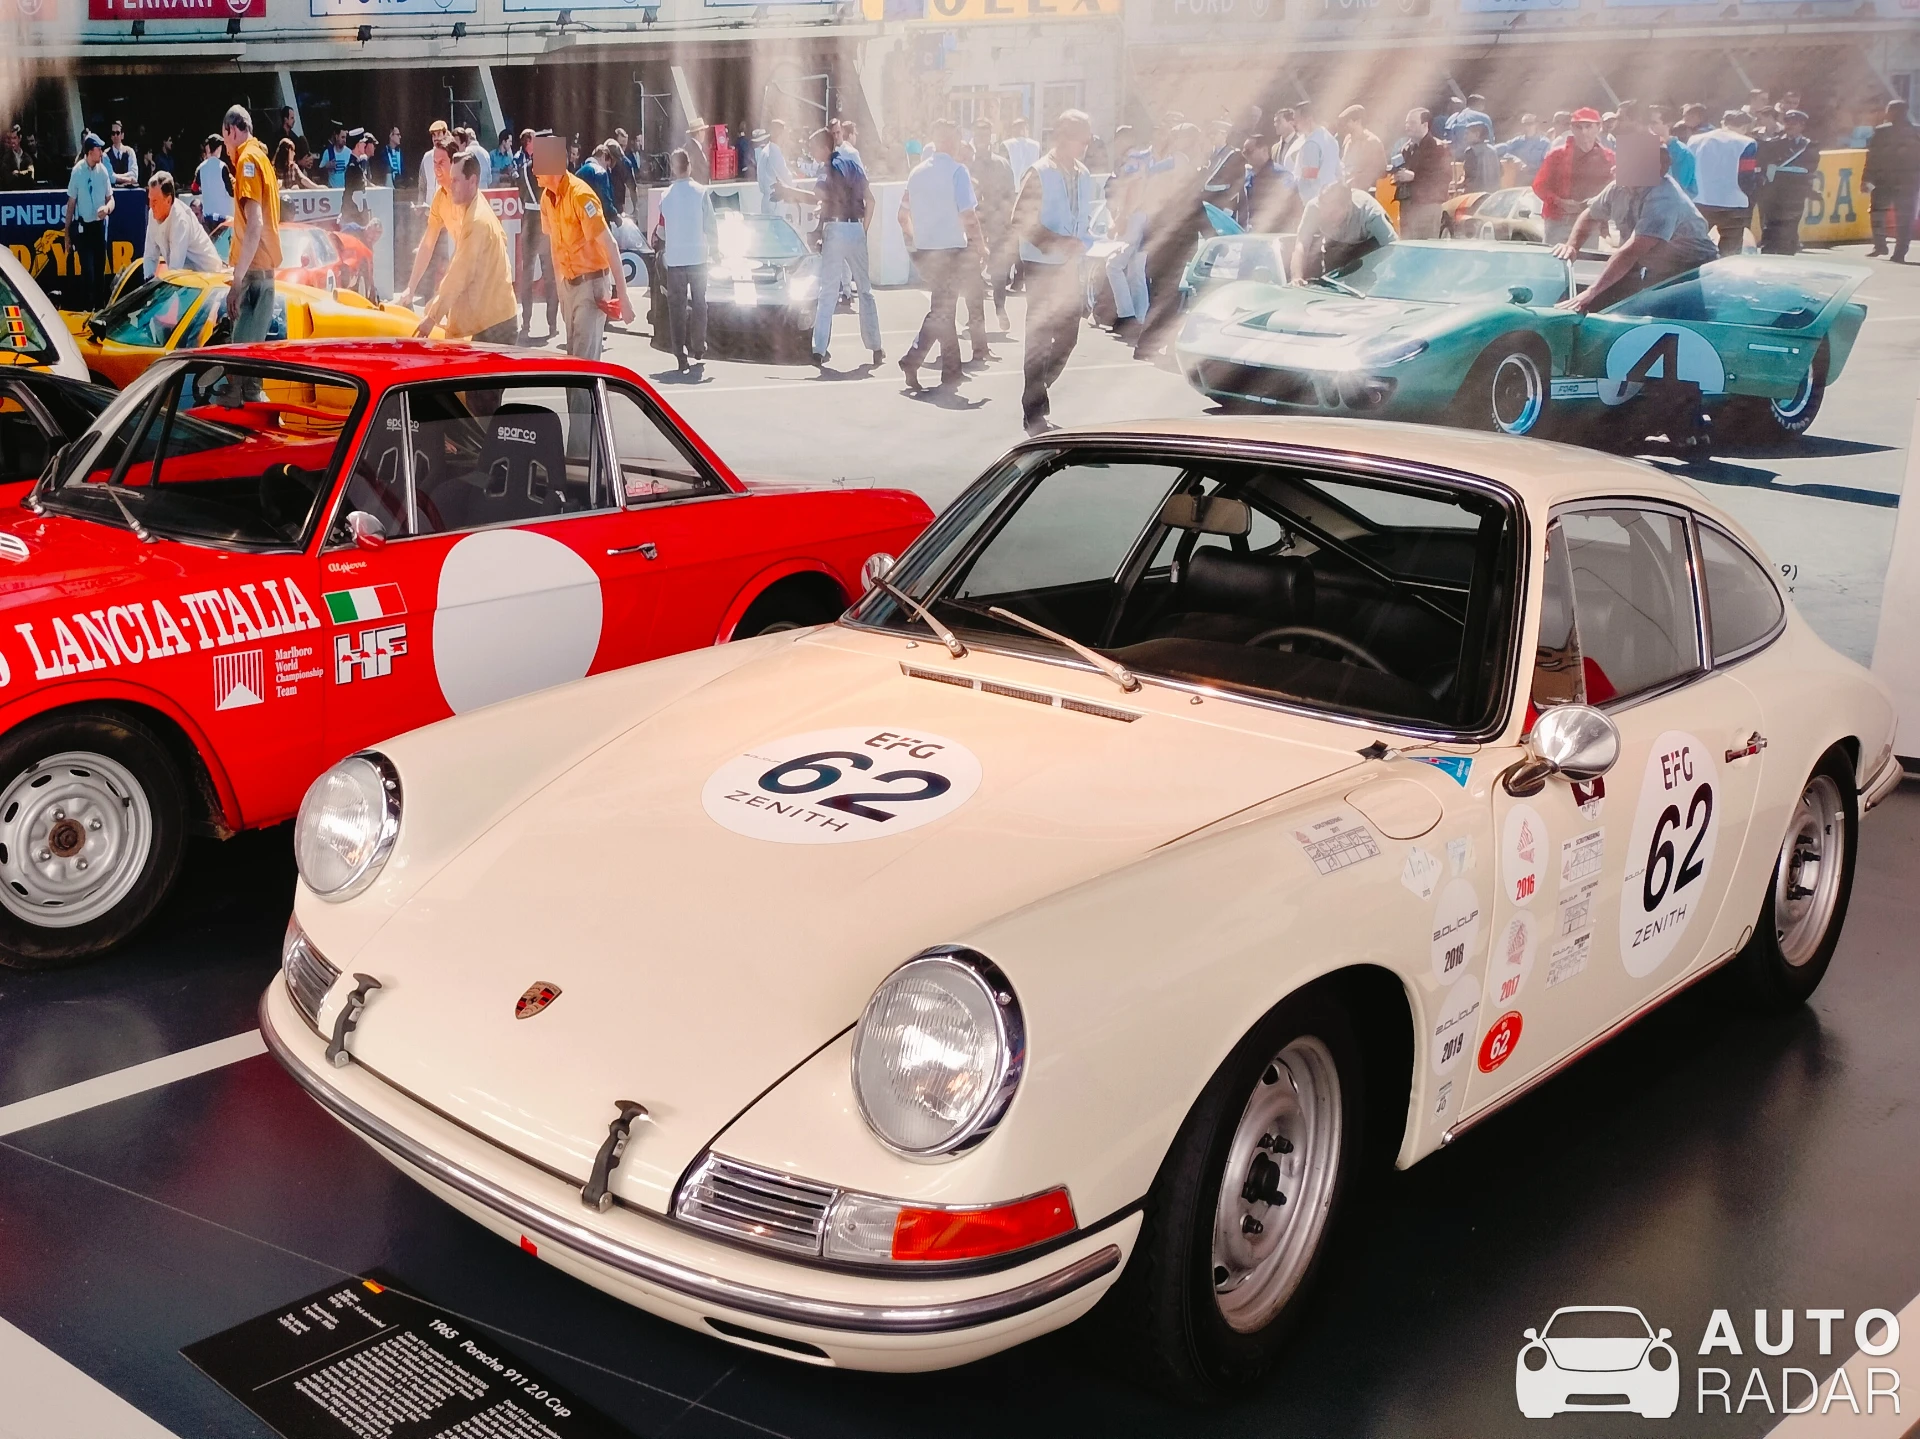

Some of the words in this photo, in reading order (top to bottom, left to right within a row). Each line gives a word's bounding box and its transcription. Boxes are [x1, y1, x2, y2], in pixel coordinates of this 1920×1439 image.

[497, 426, 537, 442] sparco
[275, 645, 313, 661] Marlboro
[275, 658, 299, 673] World
[334, 623, 408, 685] HF
[275, 668, 324, 684] Championship
[276, 685, 298, 698] Team
[864, 732, 945, 759] EFG
[1660, 746, 1693, 790] EFG
[758, 750, 952, 823] 62
[723, 789, 850, 832] ZENITH
[1643, 782, 1713, 913] 62
[1516, 873, 1536, 901] 2016
[1632, 904, 1687, 948] ZENITH
[1444, 943, 1465, 973] 2018
[1500, 974, 1520, 1003] 2017
[1441, 1032, 1464, 1064] 2019
[1490, 1029, 1511, 1060] 62
[428, 1318, 459, 1341] 1965
[459, 1340, 505, 1374] Porsche
[502, 1367, 529, 1387] 911
[524, 1383, 549, 1400] 2.0
[545, 1397, 572, 1417] Cup
